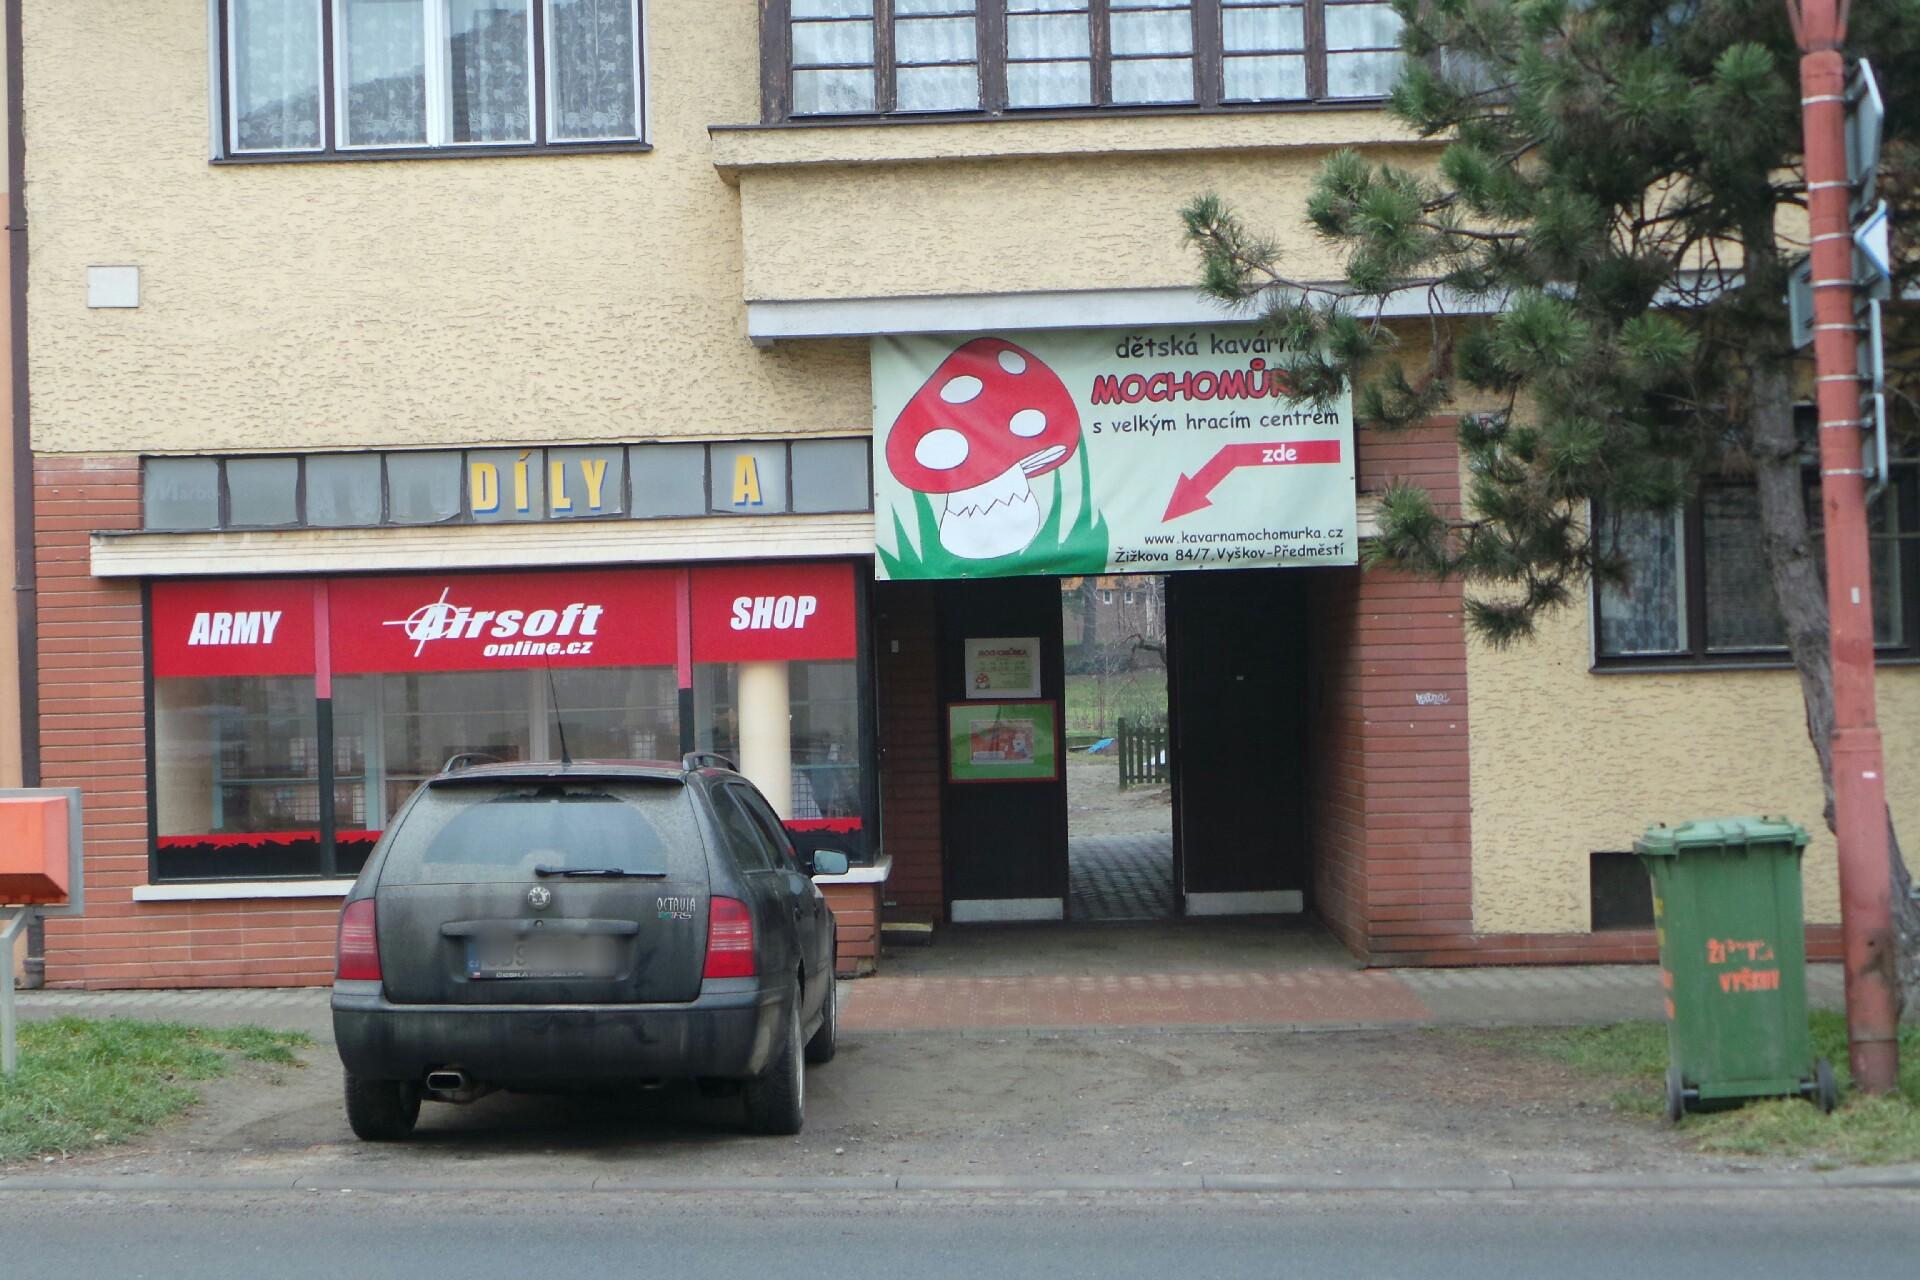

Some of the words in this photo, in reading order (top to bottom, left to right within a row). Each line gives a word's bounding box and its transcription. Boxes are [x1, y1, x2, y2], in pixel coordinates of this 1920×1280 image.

[1116, 333, 1199, 359] dětská
[1211, 330, 1293, 356] kavárn
[1091, 358, 1303, 405] MOCHOMŮR
[1093, 422, 1102, 434] s
[1111, 414, 1177, 437] velkým
[1186, 410, 1250, 430] hracím
[1260, 410, 1339, 428] centrem
[1262, 443, 1298, 463] zde
[471, 448, 608, 513] DÍLY
[732, 455, 763, 506] A
[1144, 526, 1344, 545] www.kavarnamochomurka.cz
[1115, 546, 1169, 563] Žižkova
[409, 603, 603, 641] Airsoft
[730, 595, 817, 630] SHOP
[188, 611, 282, 646] ARMY
[482, 641, 593, 657] online.cz
[656, 896, 696, 912] OCTAVIA
